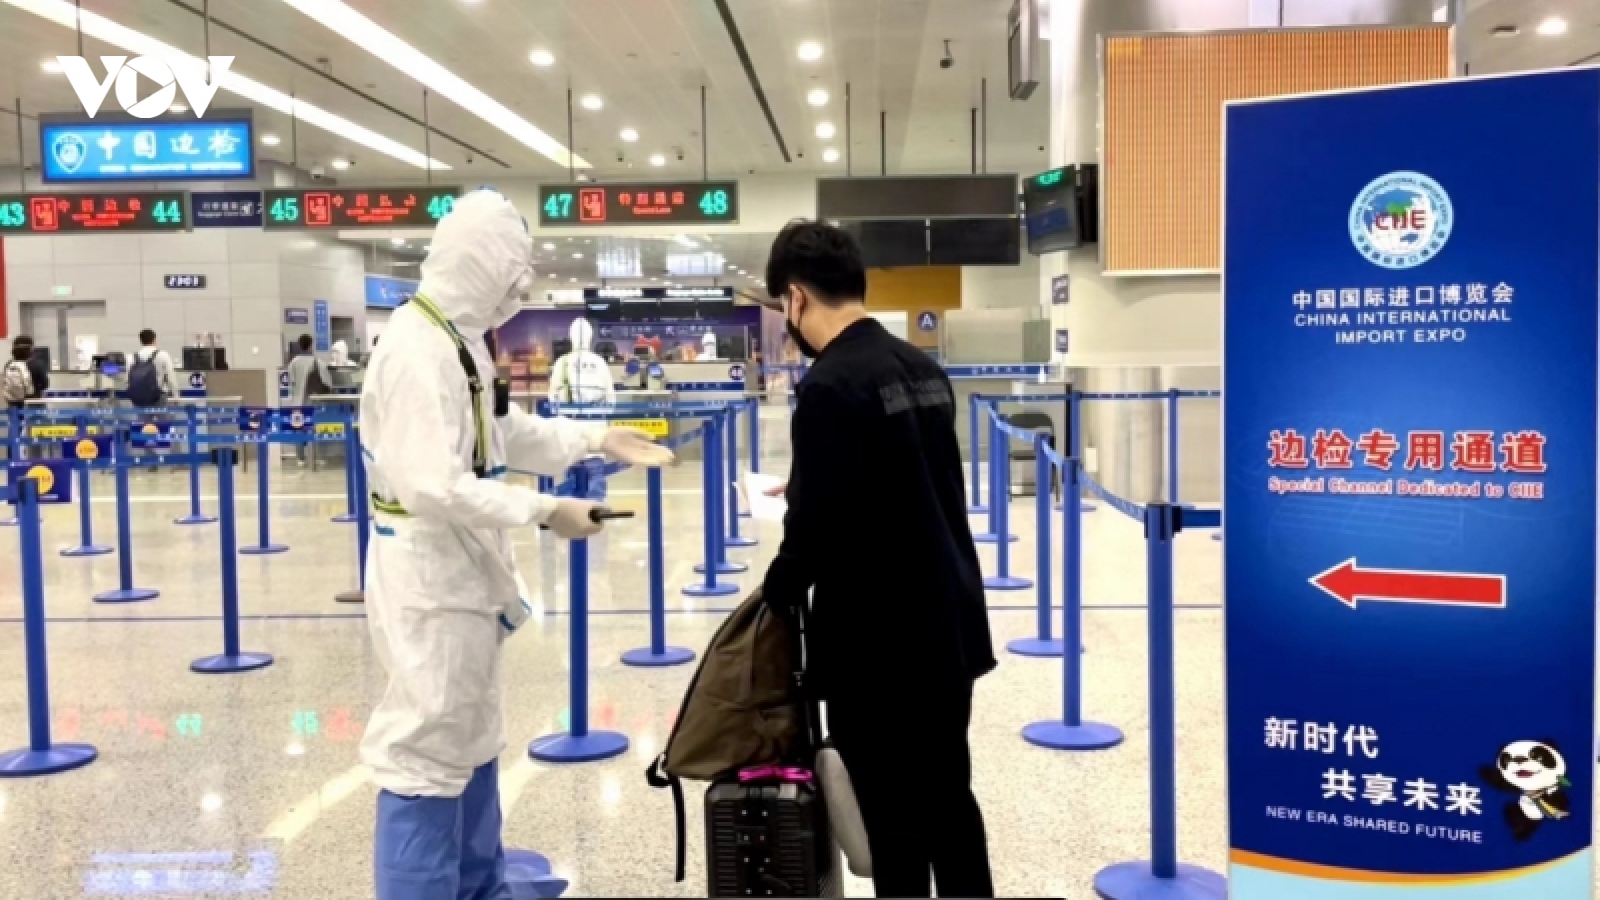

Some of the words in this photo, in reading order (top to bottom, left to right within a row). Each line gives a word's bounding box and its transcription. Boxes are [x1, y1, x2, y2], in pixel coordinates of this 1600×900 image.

[152, 199, 182, 223] 44
[269, 197, 299, 221] 45
[544, 193, 573, 218] 47
[698, 189, 729, 215] 48
[1292, 281, 1515, 311] 中国国际进口博览会
[1294, 313, 1350, 327] CHINA
[1357, 308, 1513, 325] INTERNATIONAL
[1335, 329, 1407, 344] IMPORT
[1413, 328, 1467, 343] EXPO
[1267, 428, 1547, 473] 边检专用通道
[1268, 476, 1325, 495] Special
[1328, 477, 1393, 495] Channel
[1397, 479, 1481, 498] Dedicated
[1484, 482, 1504, 499] to
[1264, 715, 1379, 759] 新时代
[1321, 767, 1483, 816] 共享未来
[1265, 805, 1302, 821] NEW
[1306, 810, 1339, 825] ERA
[1343, 815, 1411, 835] SHARED
[1415, 823, 1483, 844] FUTURE
